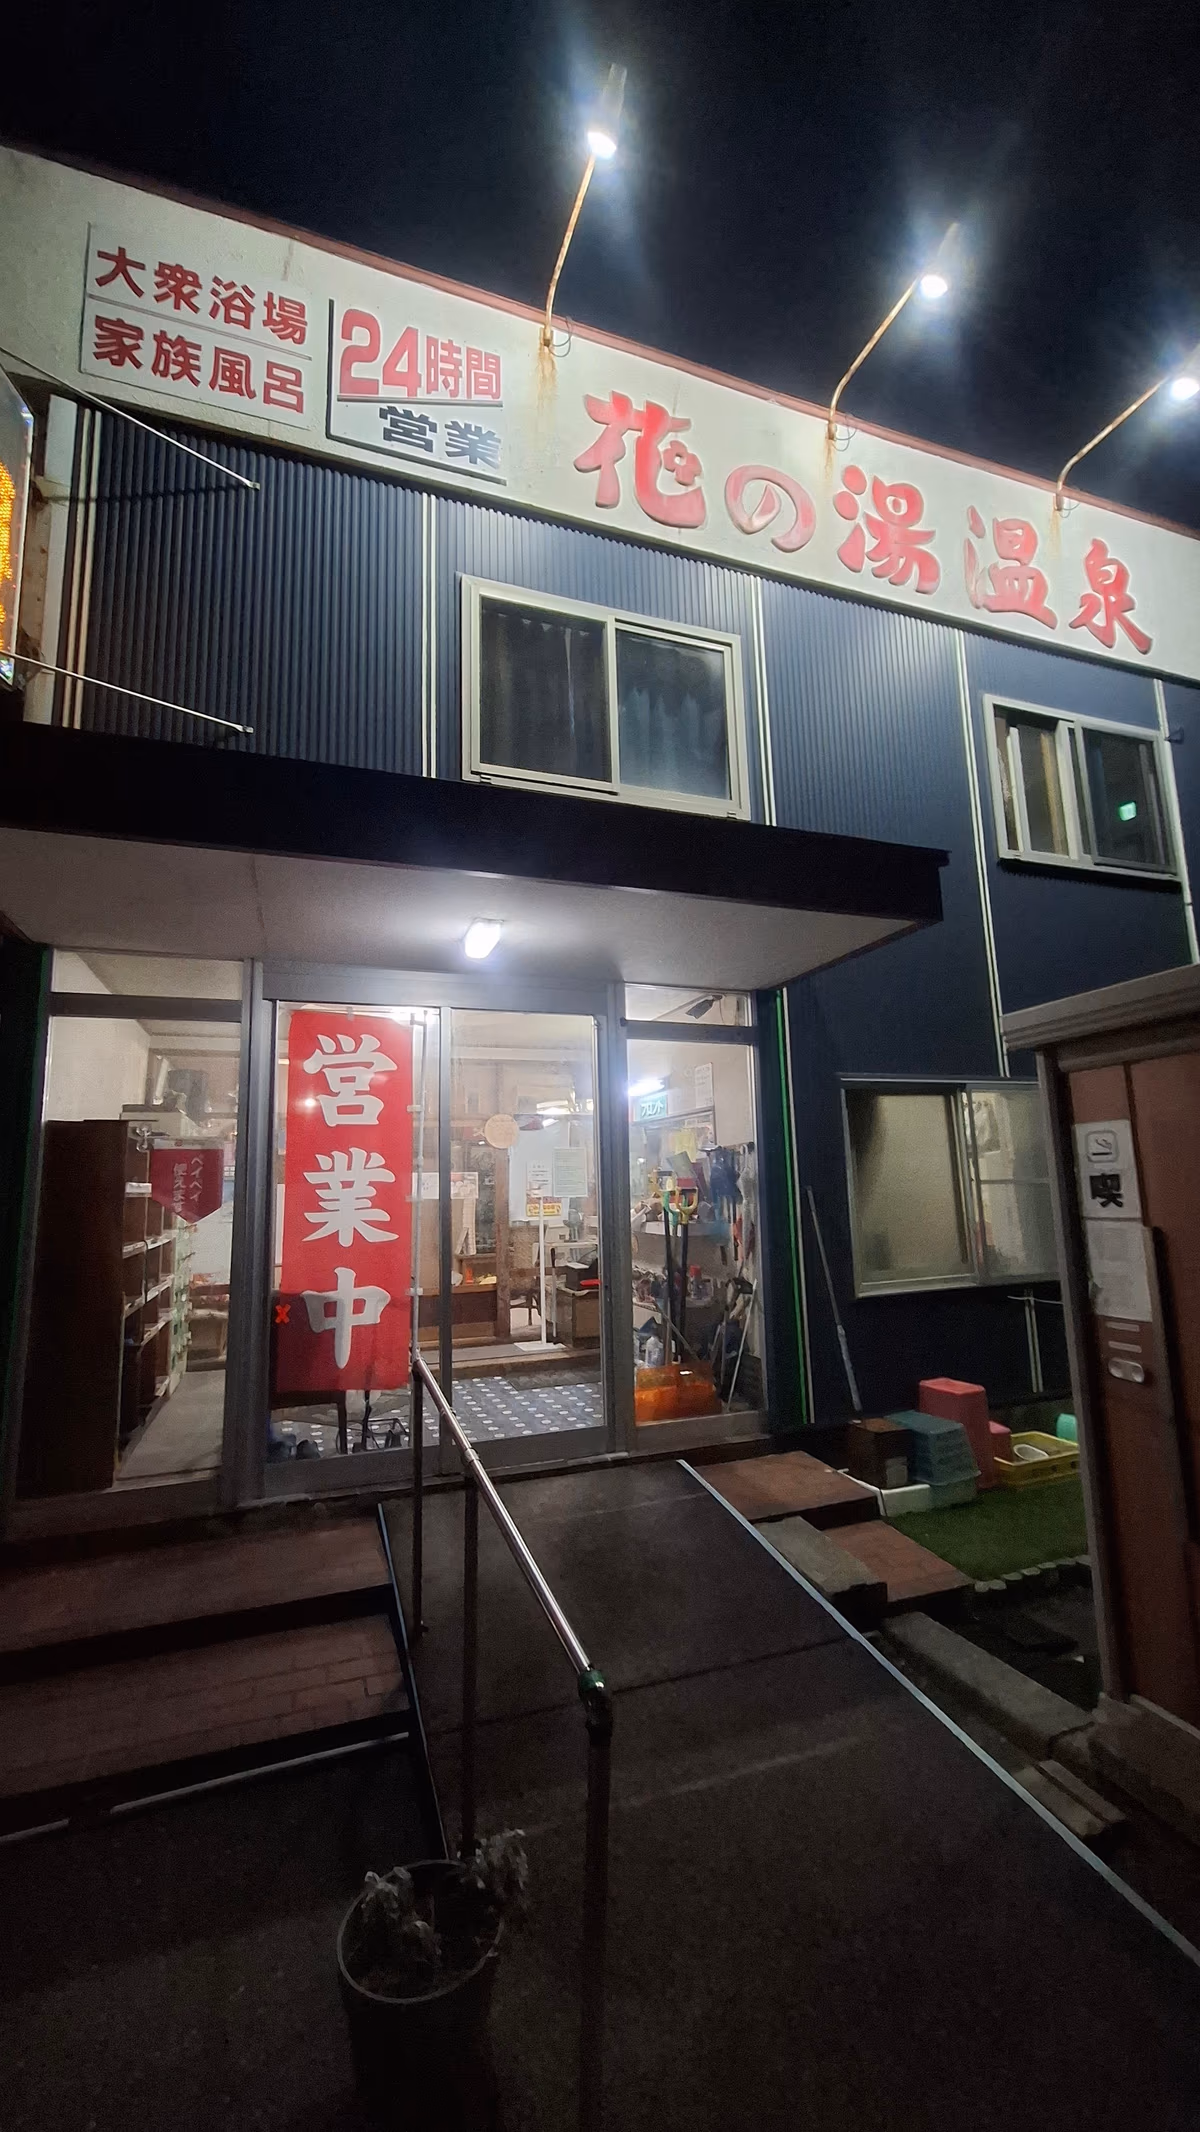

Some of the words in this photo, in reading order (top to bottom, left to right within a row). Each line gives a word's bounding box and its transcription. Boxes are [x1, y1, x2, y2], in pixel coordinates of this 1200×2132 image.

[95, 246, 310, 345] 大衆浴場
[93, 315, 305, 414] 家族風呂
[339, 308, 502, 399] 24時間
[379, 405, 501, 469] 営業
[573, 390, 1154, 655] 花の湯温泉
[301, 1034, 399, 1370] 営業中
